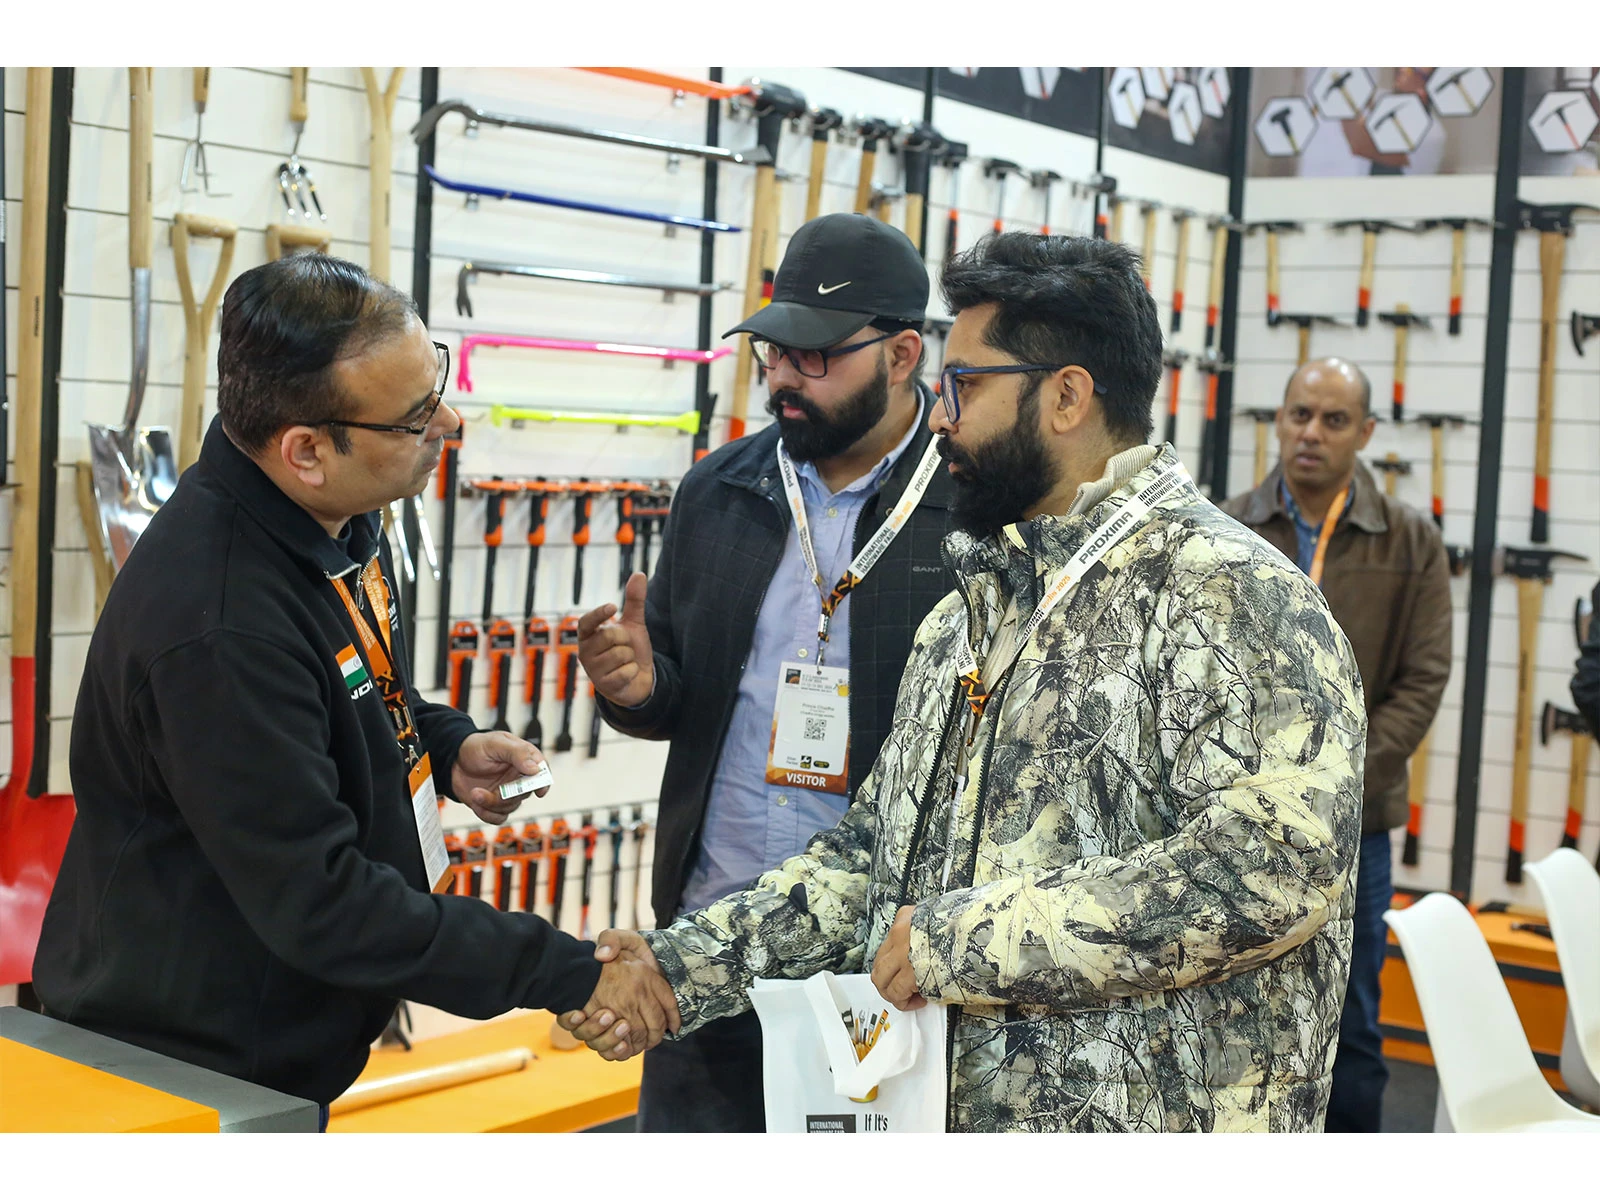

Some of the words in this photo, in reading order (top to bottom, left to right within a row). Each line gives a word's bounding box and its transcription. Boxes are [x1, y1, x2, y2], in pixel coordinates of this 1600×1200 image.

[1078, 511, 1134, 565] PROXIMA
[855, 526, 893, 570] INTERNATIONAL
[912, 565, 943, 574] GANT
[1056, 575, 1071, 592] 2025
[786, 772, 827, 788] VISITOR
[809, 1121, 844, 1130] INTERNATIONAL
[865, 1114, 872, 1131] If
[874, 1114, 888, 1131] It's
